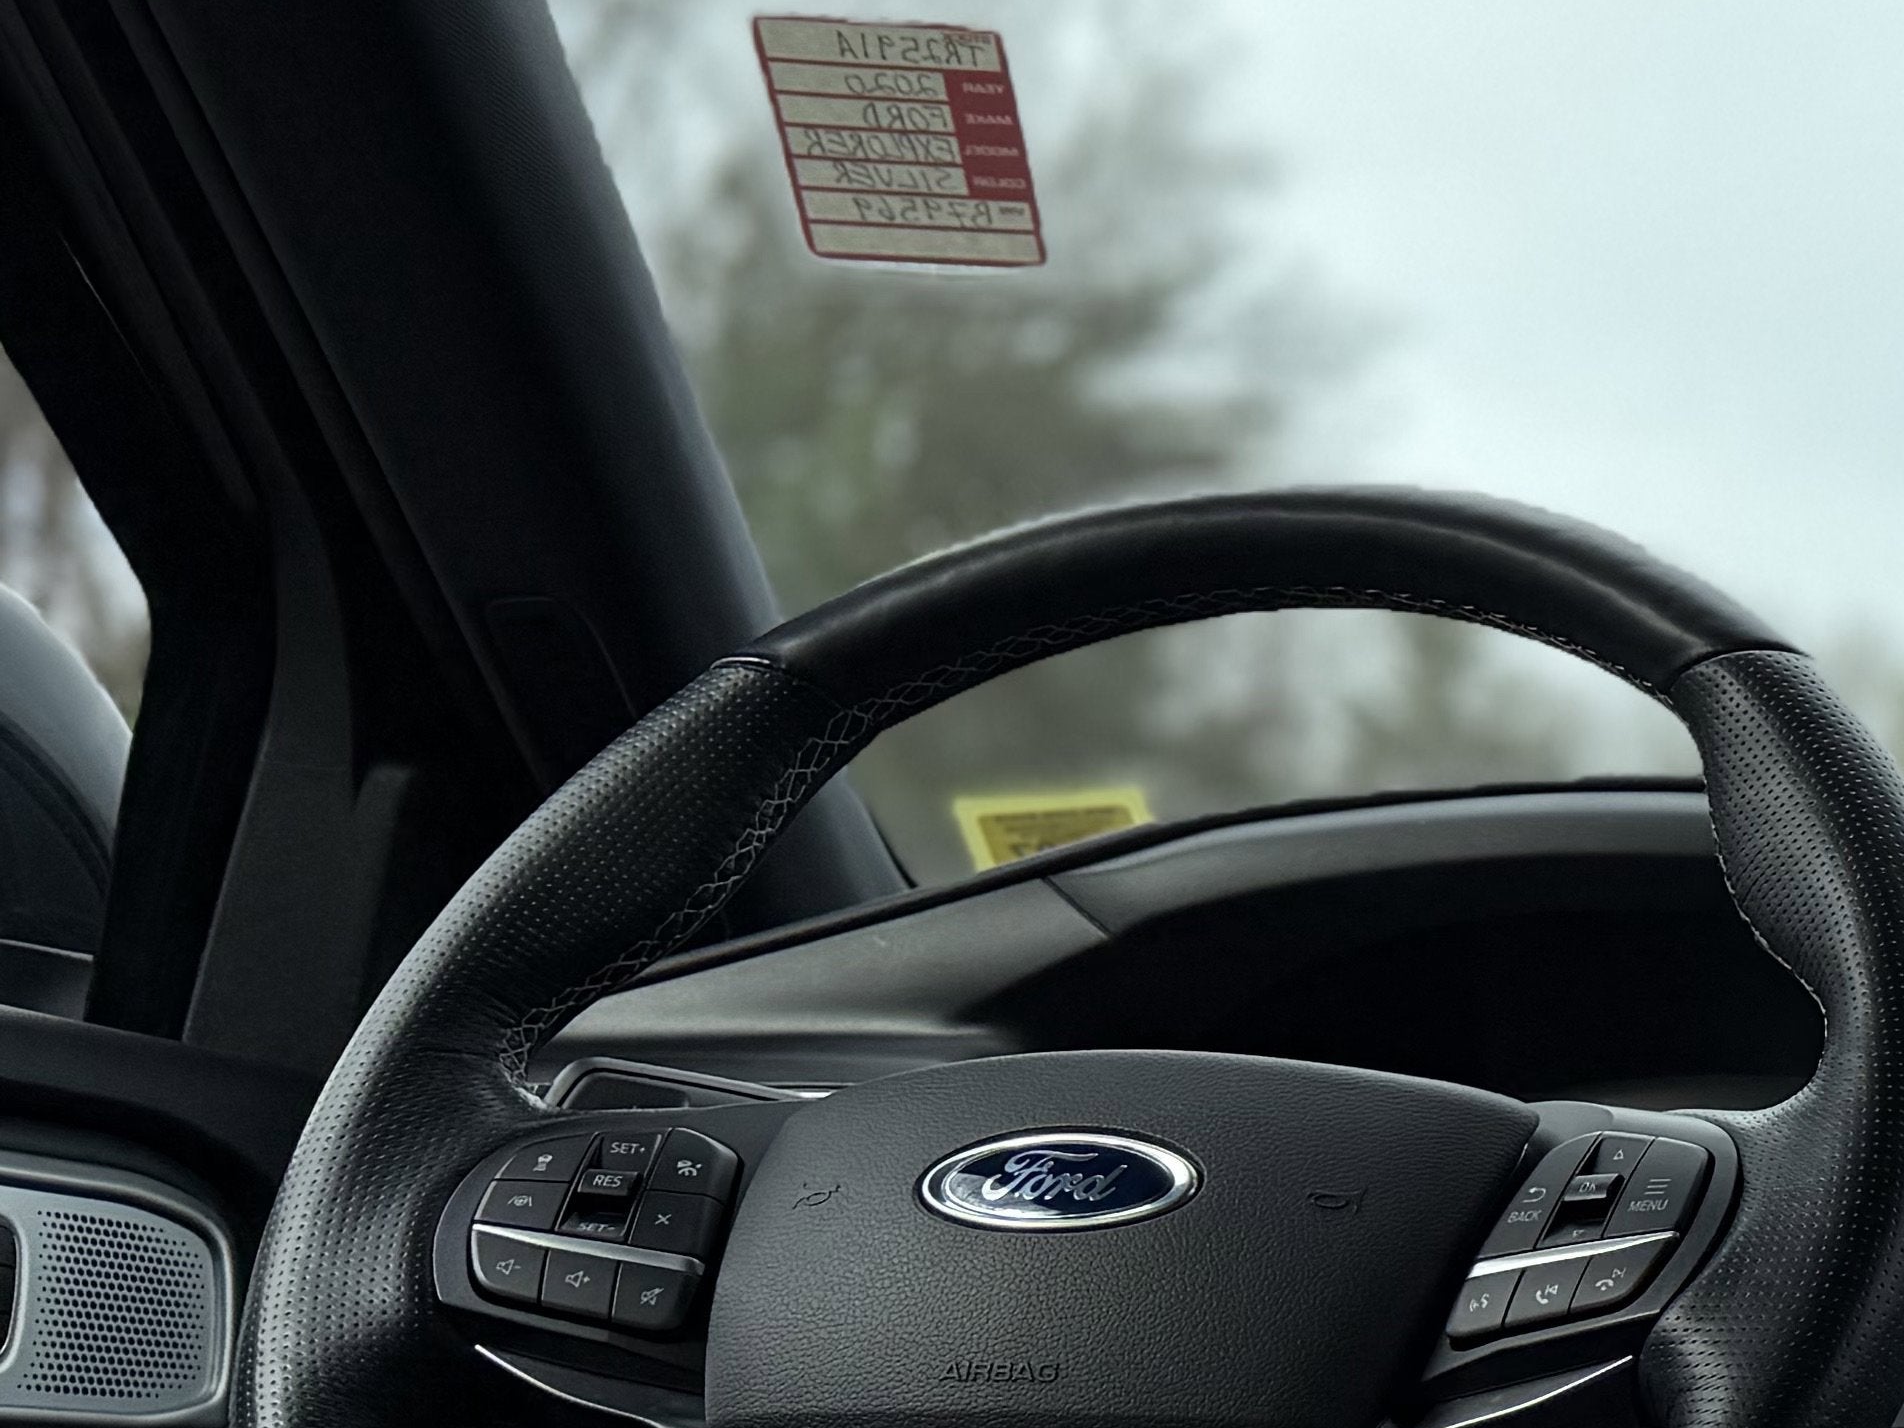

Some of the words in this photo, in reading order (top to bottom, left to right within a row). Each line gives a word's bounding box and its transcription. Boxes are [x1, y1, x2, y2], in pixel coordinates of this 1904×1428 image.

[592, 1174, 624, 1188] RES
[981, 1150, 1128, 1202] Ford
[1627, 1198, 1670, 1213] MENU
[1506, 1209, 1543, 1224] BACK
[939, 1361, 1061, 1383] AIRBAG
